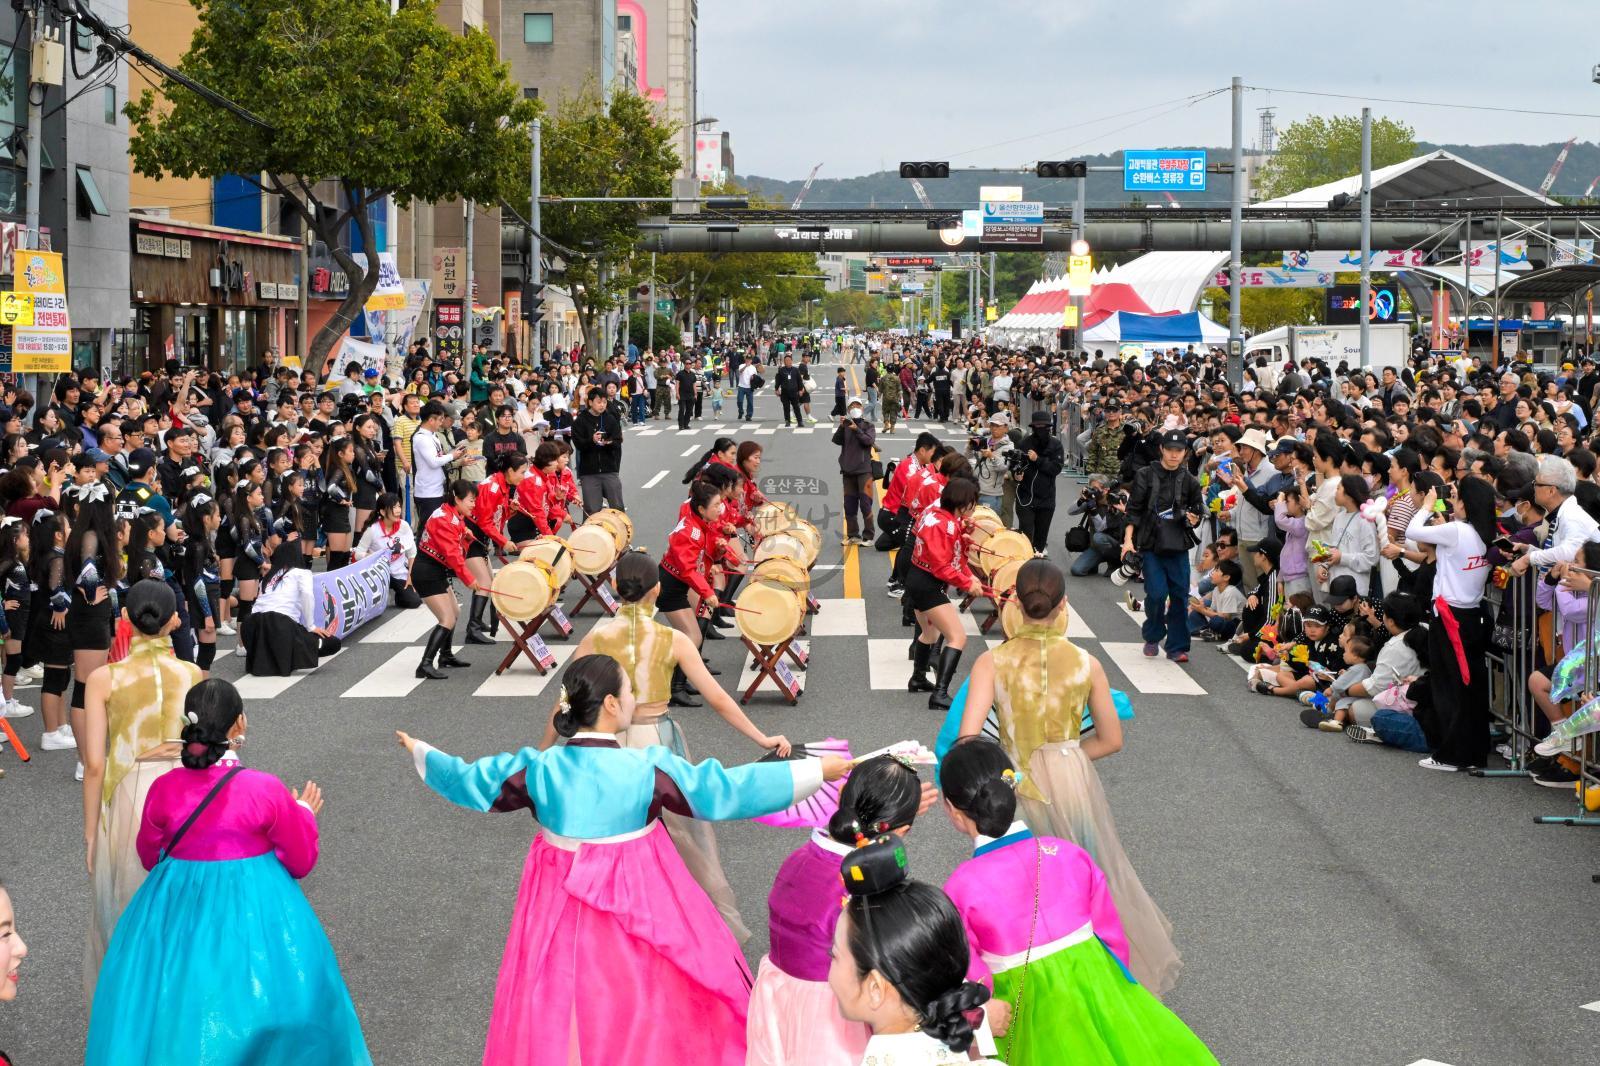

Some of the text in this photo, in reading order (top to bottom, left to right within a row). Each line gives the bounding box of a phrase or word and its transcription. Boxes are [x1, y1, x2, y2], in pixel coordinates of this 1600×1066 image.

[1133, 172, 1184, 184] 순환버스 정류장
[999, 204, 1040, 212] 울산항만공사
[443, 255, 456, 295] 십원빵
[38, 312, 67, 327] 전면통제
[336, 574, 368, 634] 울산
